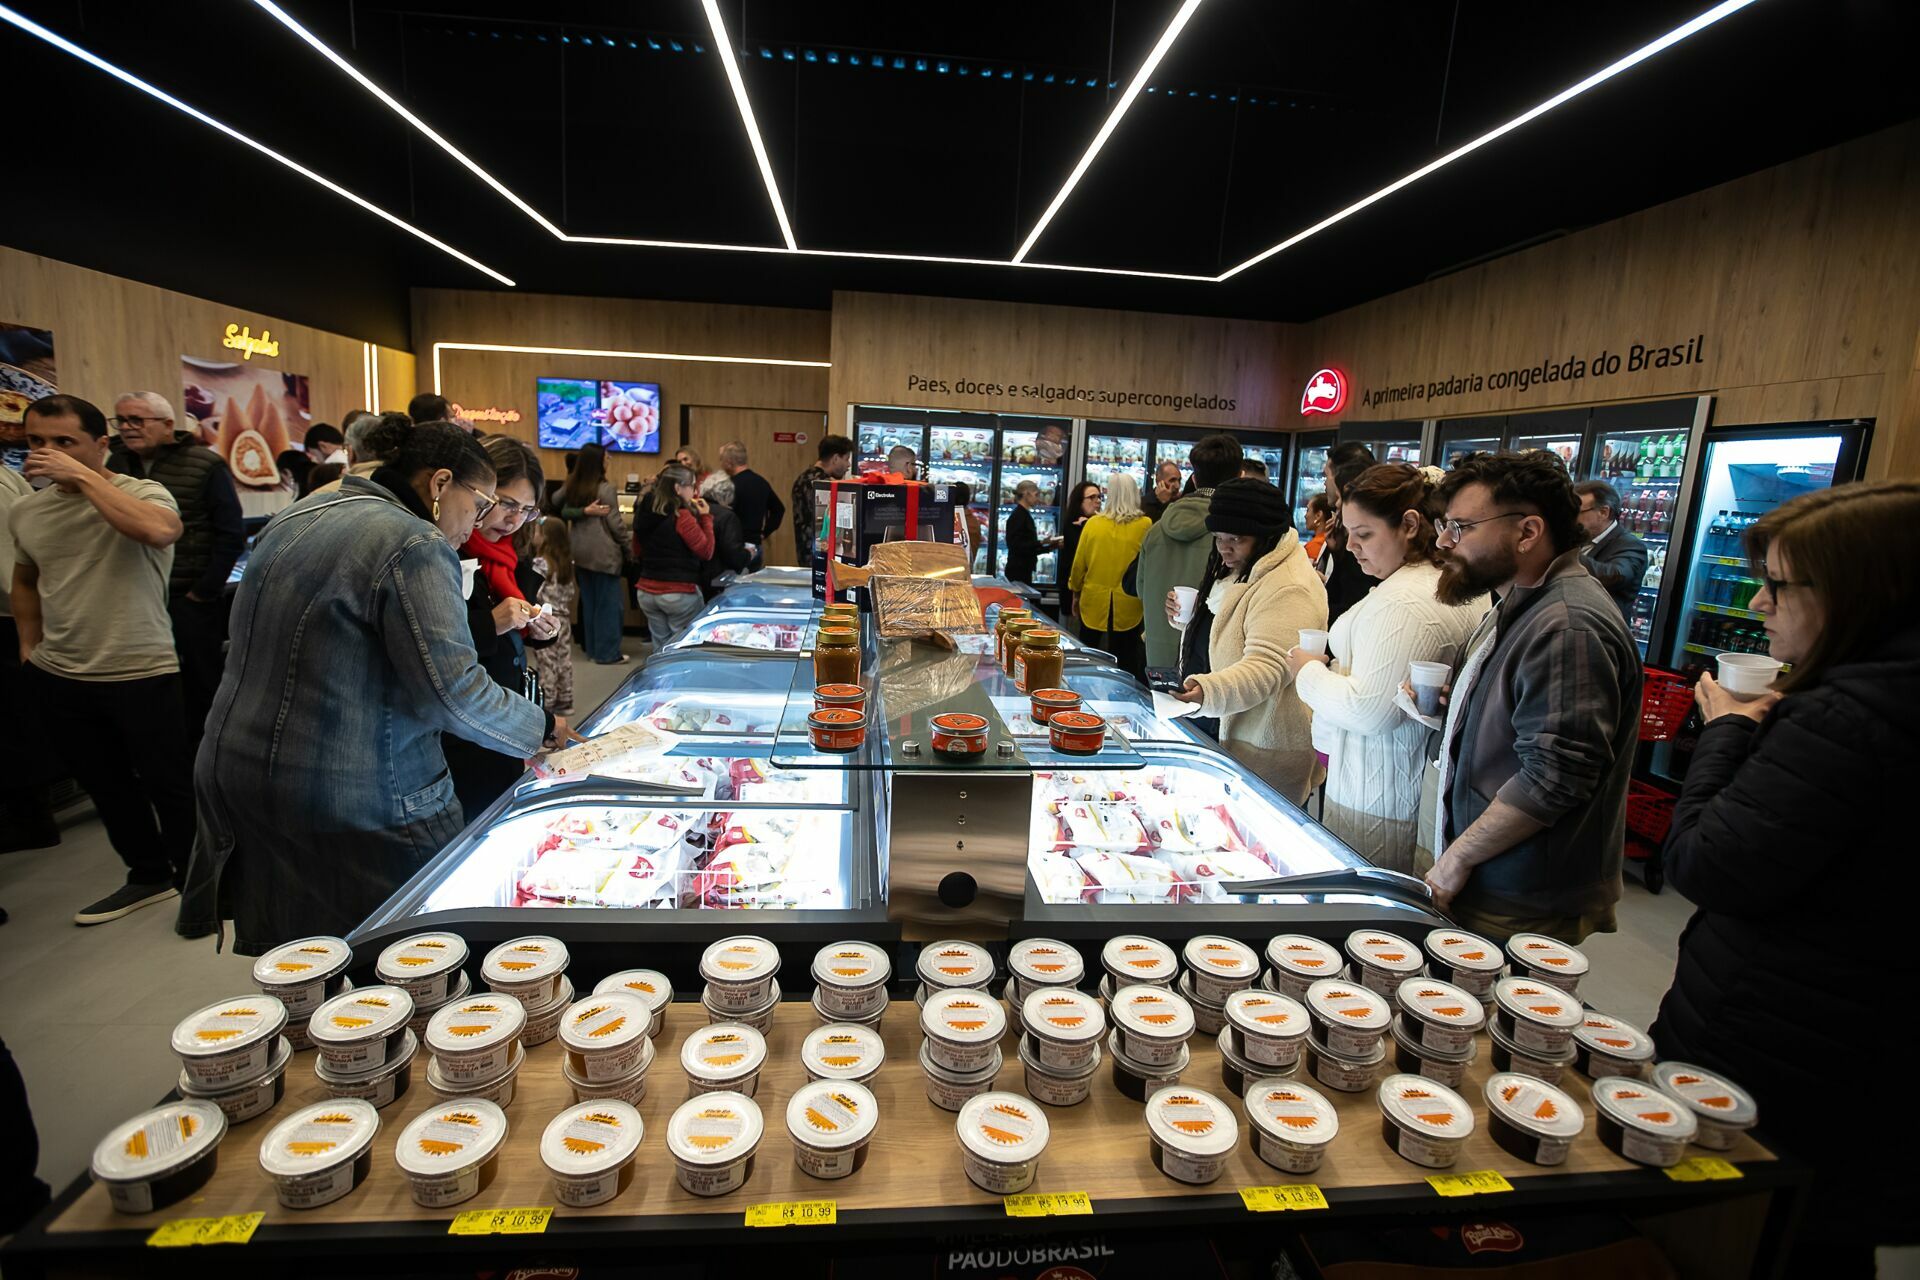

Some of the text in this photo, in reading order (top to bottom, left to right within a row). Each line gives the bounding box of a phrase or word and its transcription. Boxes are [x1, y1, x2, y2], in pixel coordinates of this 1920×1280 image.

[1362, 334, 1704, 409] A primeira padaria congelada do Brasil
[955, 378, 1004, 396] doces
[1008, 384, 1018, 397] e
[1021, 383, 1094, 404] salgados
[1098, 390, 1237, 412] supercongelados
[491, 1215, 506, 1225] R$
[783, 1207, 831, 1218] R$ 10.99
